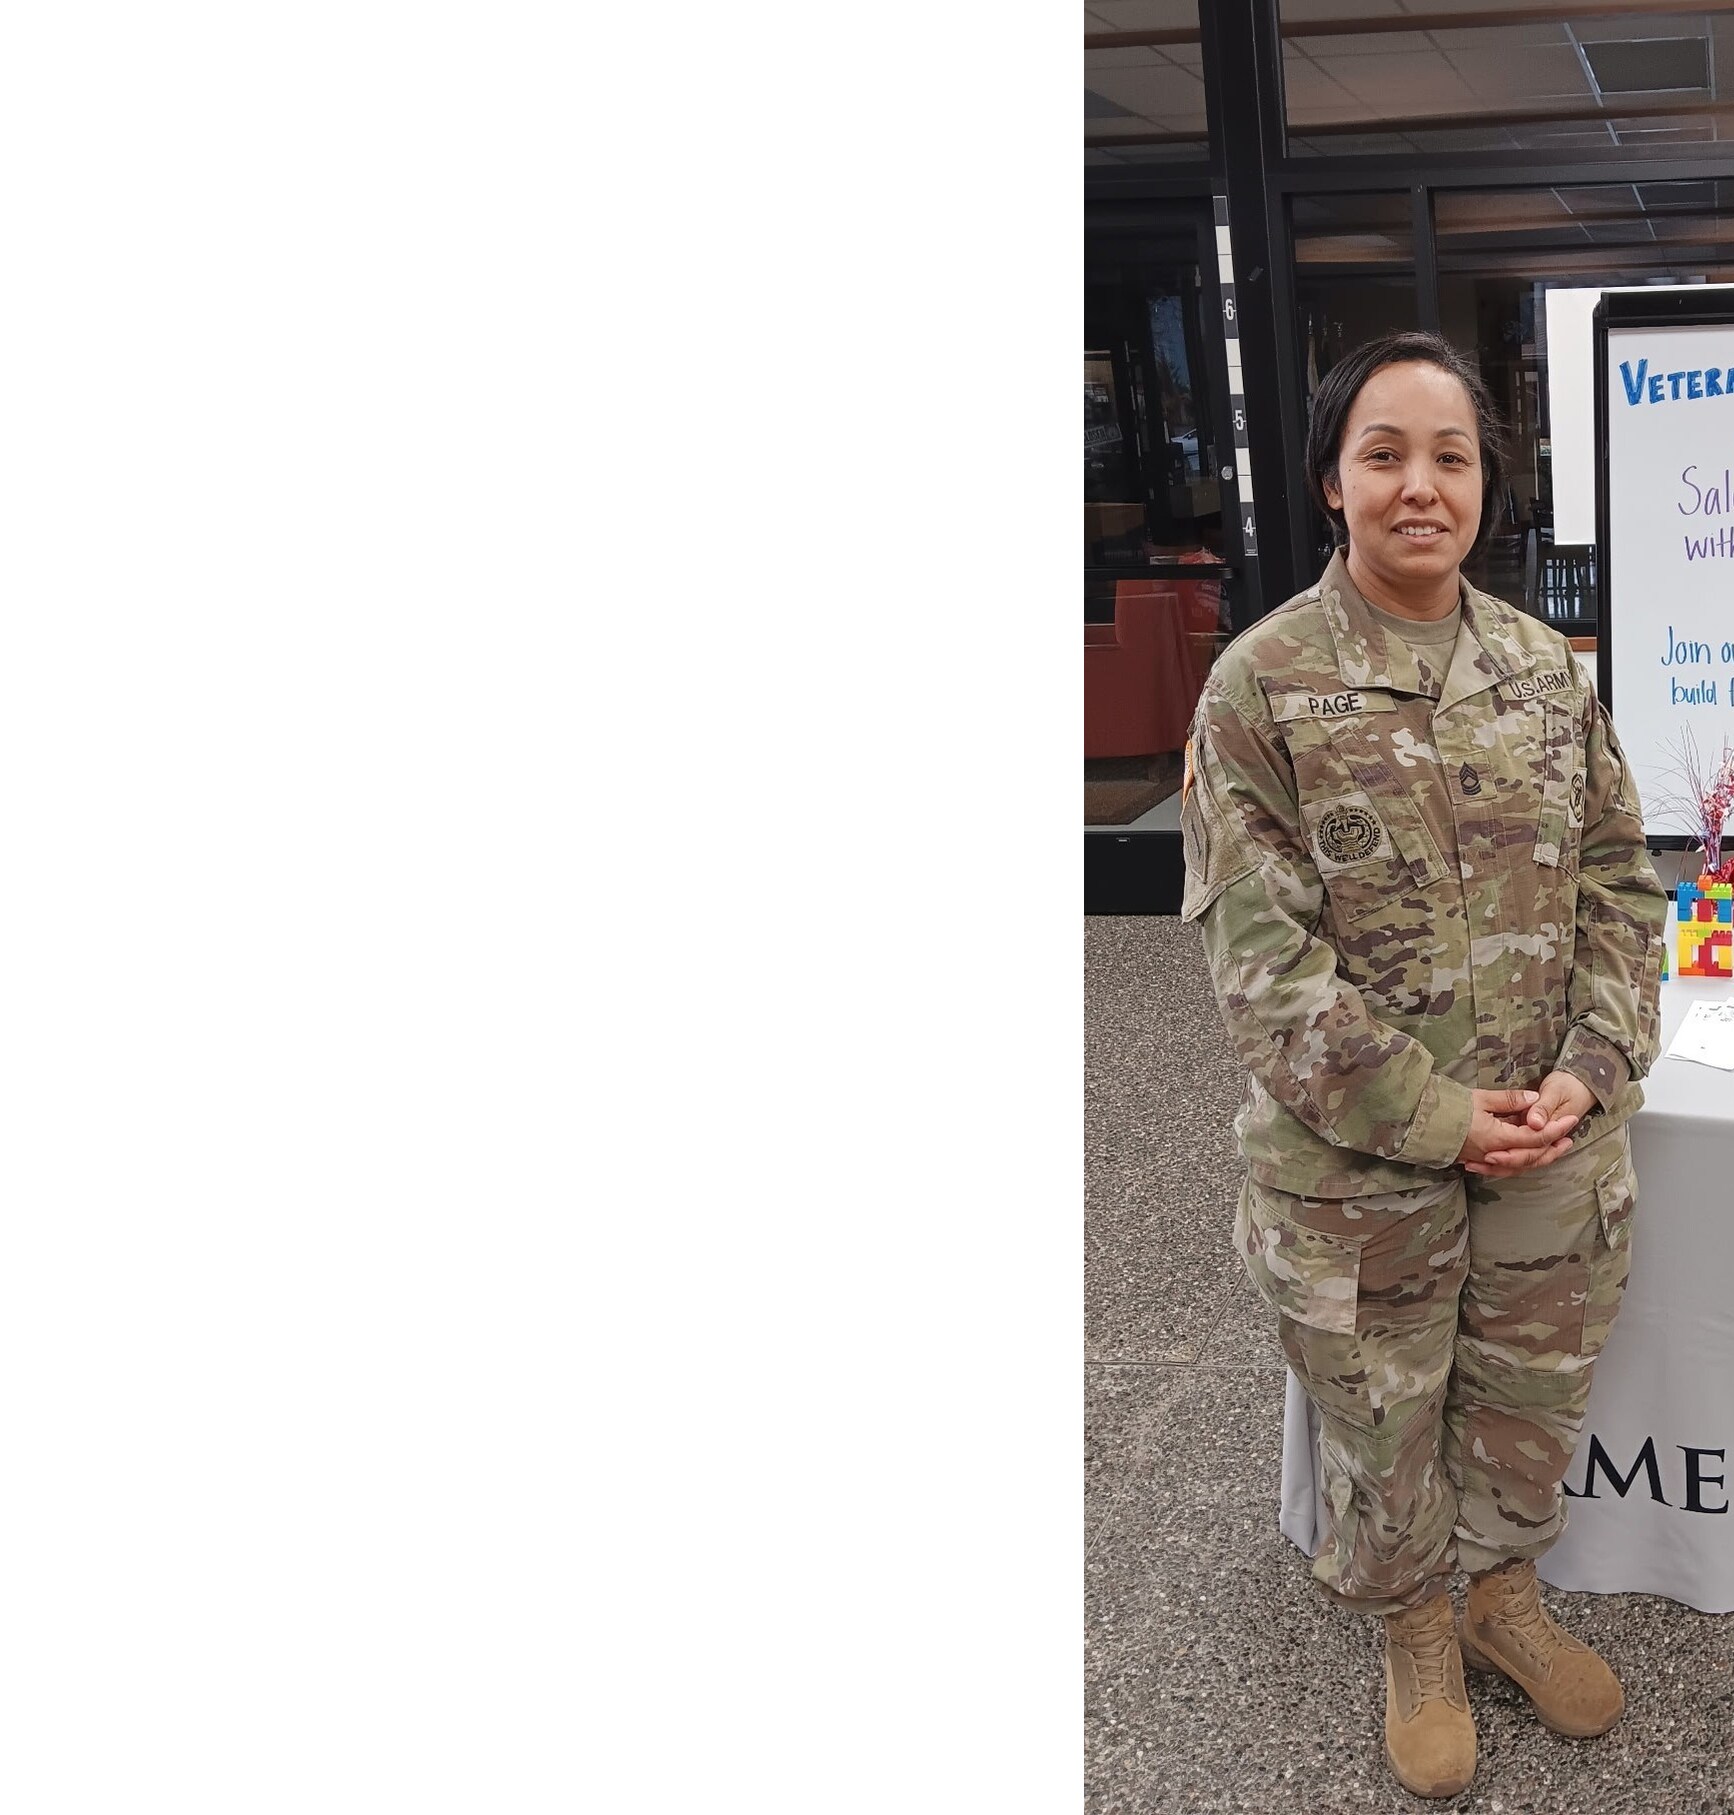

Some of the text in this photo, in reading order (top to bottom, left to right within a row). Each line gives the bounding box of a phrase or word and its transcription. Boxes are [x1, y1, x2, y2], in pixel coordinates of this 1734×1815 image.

[1224, 298, 1235, 321] 6
[1234, 410, 1245, 430] 5
[1244, 517, 1255, 537] 4
[1660, 626, 1712, 667] Join
[1671, 677, 1718, 706] build
[1307, 692, 1362, 716] PAGE
